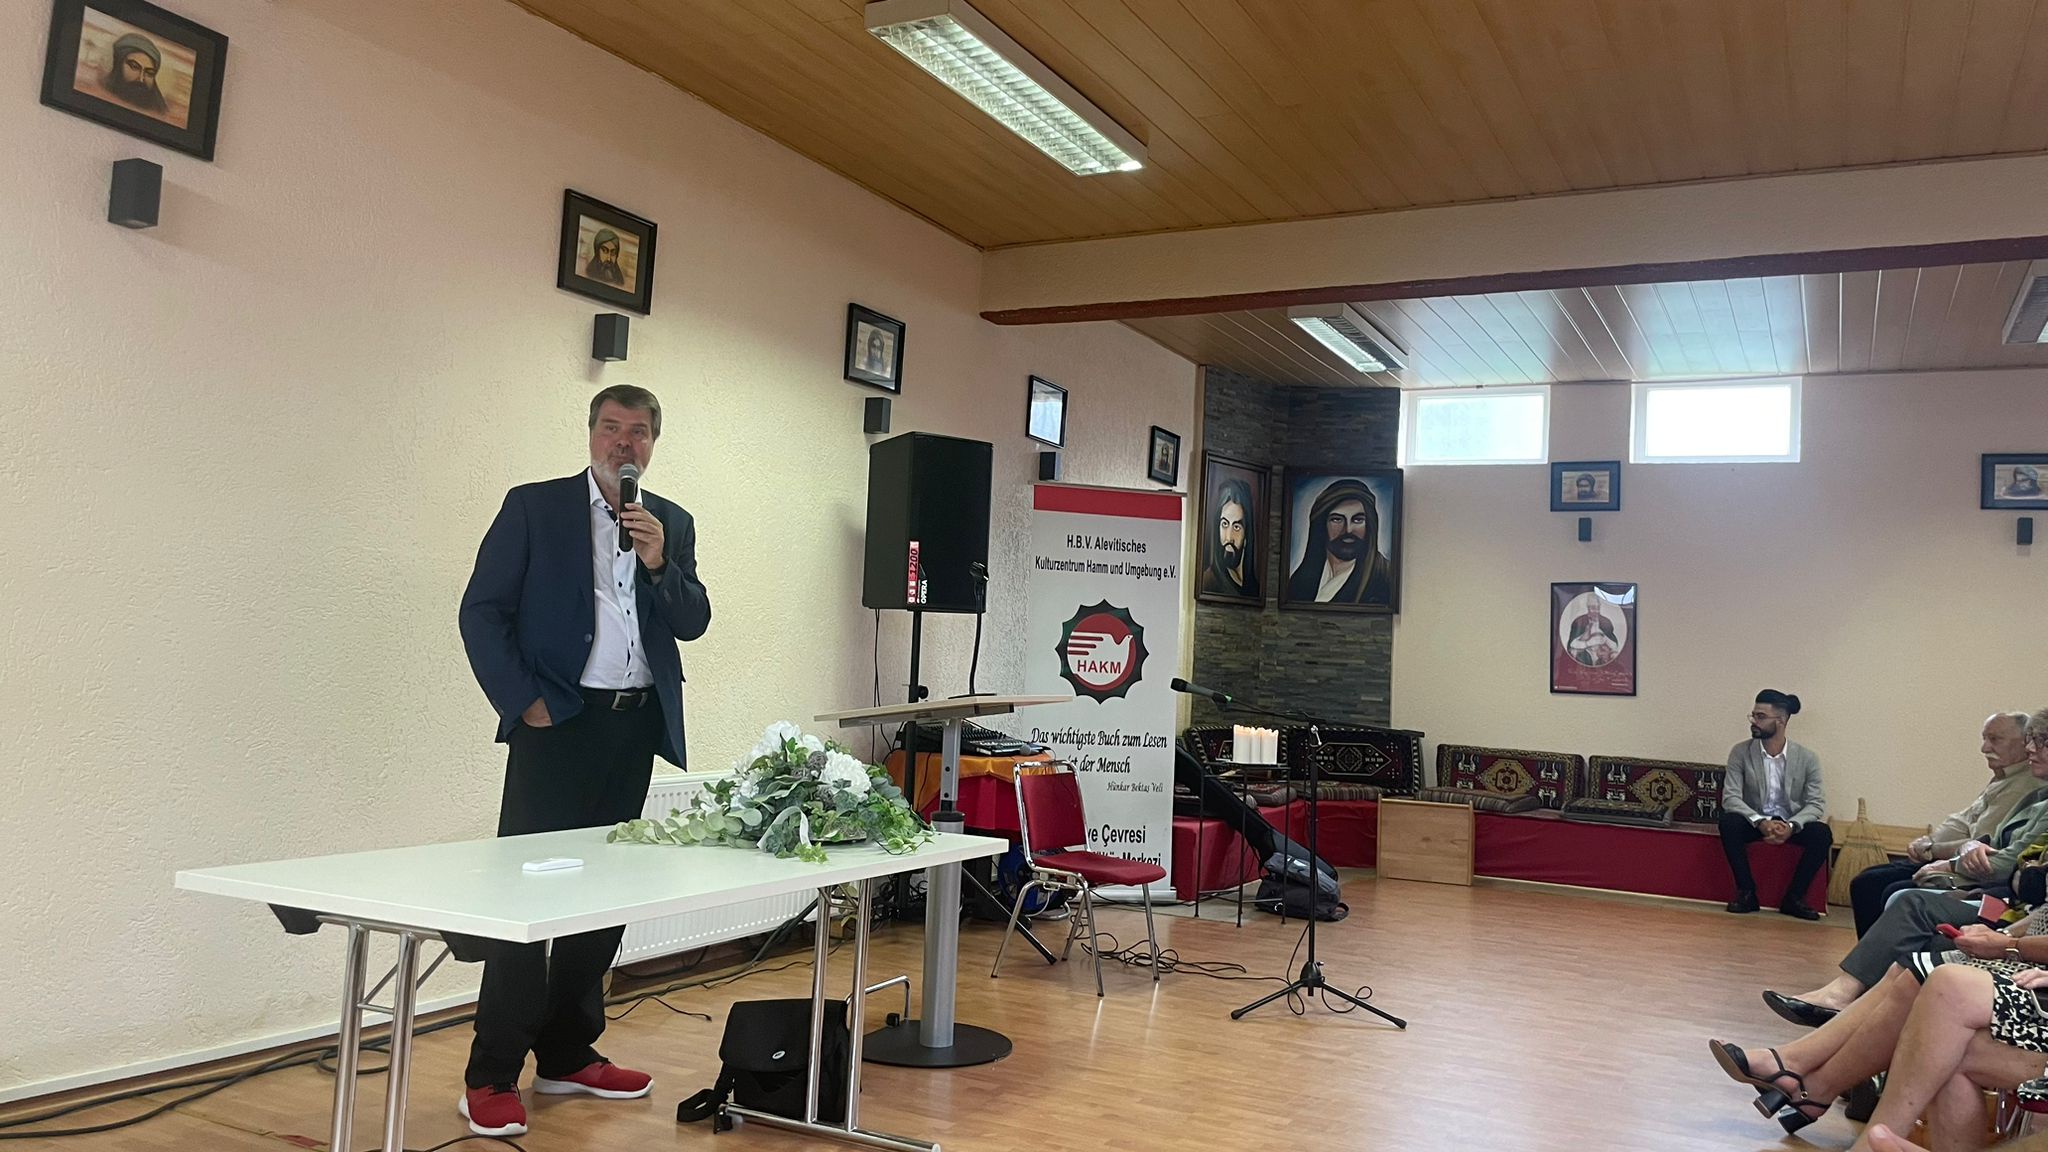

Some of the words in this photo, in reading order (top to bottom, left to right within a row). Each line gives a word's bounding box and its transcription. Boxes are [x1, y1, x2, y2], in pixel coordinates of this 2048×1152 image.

[1066, 534, 1093, 550] H.B.V.
[1094, 536, 1147, 554] Alevitisches
[1035, 555, 1086, 573] Kulturzentrum
[1086, 559, 1109, 574] Hamm
[1109, 561, 1124, 575] und
[1124, 562, 1162, 581] Umgebung
[1163, 565, 1177, 579] e.V.
[1077, 660, 1121, 674] HAKM
[1030, 727, 1049, 744] Das
[1050, 727, 1096, 751] wichtigste
[1097, 729, 1120, 747] Buch
[1121, 735, 1141, 748] zum
[1142, 732, 1167, 749] Lesen
[1080, 754, 1096, 772] der
[1096, 756, 1131, 774] Mensch
[1106, 781, 1130, 793] Hünkar
[1151, 782, 1164, 793] Veli
[1102, 824, 1146, 847] Çevresi
